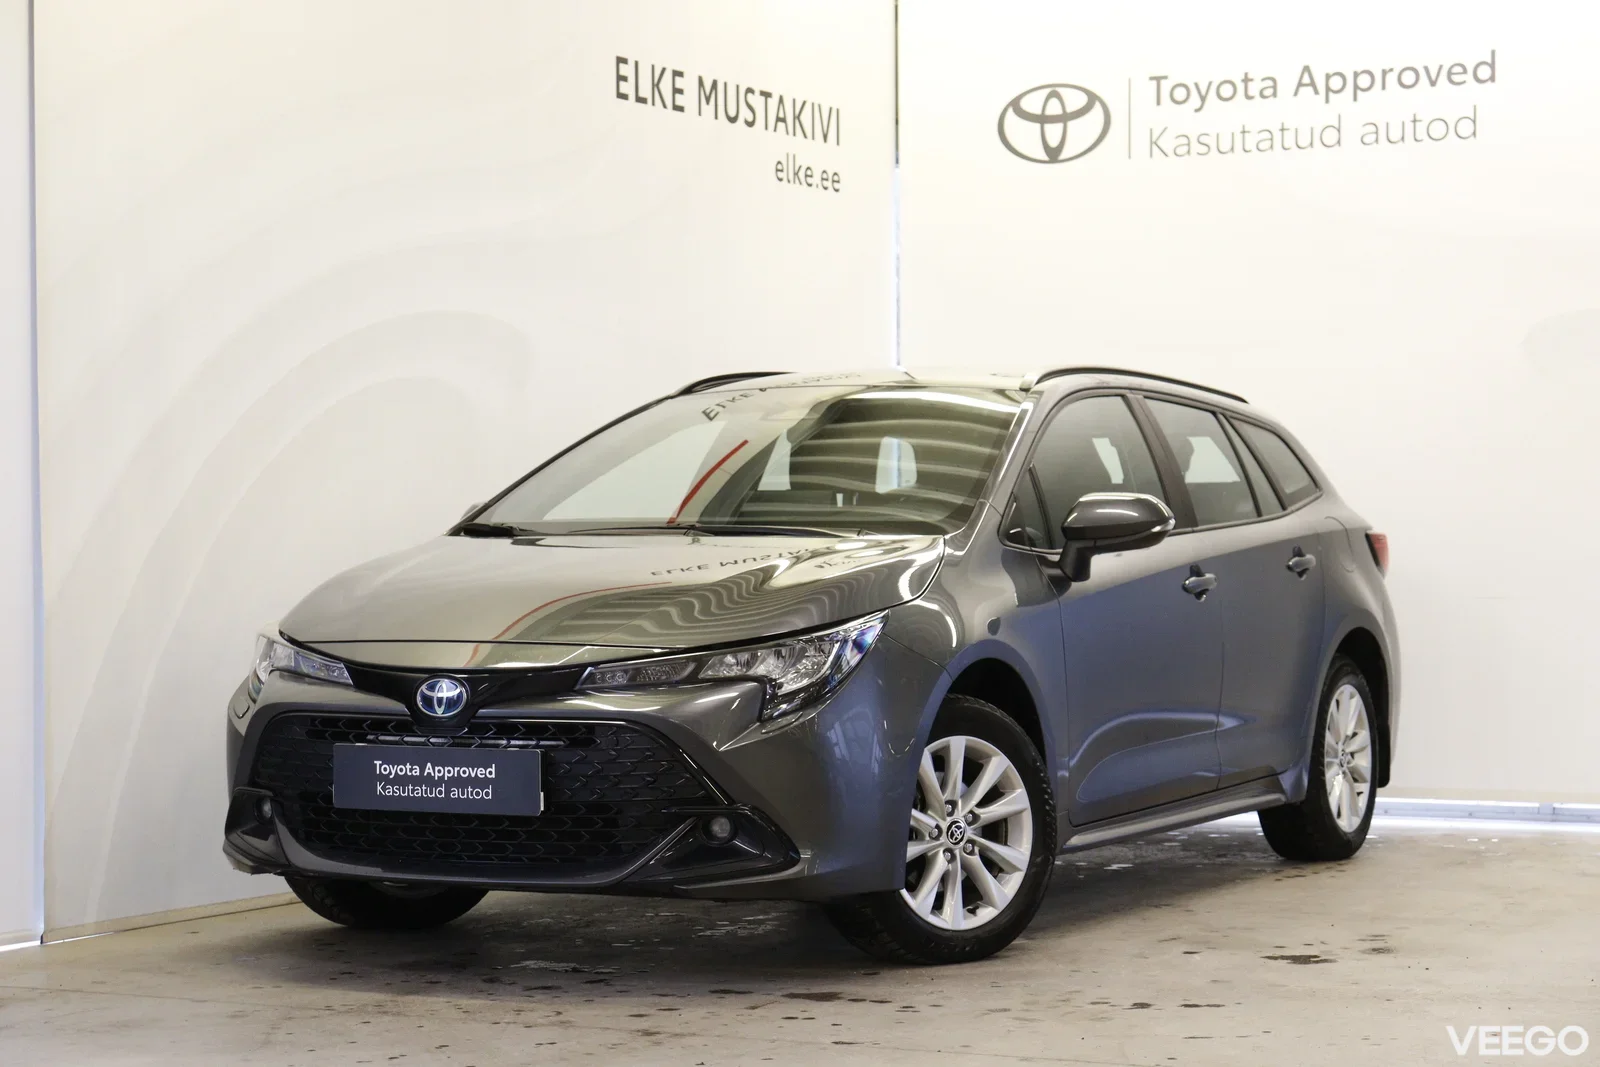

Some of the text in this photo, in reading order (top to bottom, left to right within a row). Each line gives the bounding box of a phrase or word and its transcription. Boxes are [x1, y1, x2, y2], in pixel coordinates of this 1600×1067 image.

[615, 55, 840, 147] ELKE MUSTAKIVI
[1148, 48, 1496, 113] Toyota Approved
[1149, 105, 1477, 158] Kasutatud autod
[774, 152, 841, 193] elke.ee
[373, 760, 496, 781] Toyota Approved
[376, 781, 492, 800] Kasutatud autod
